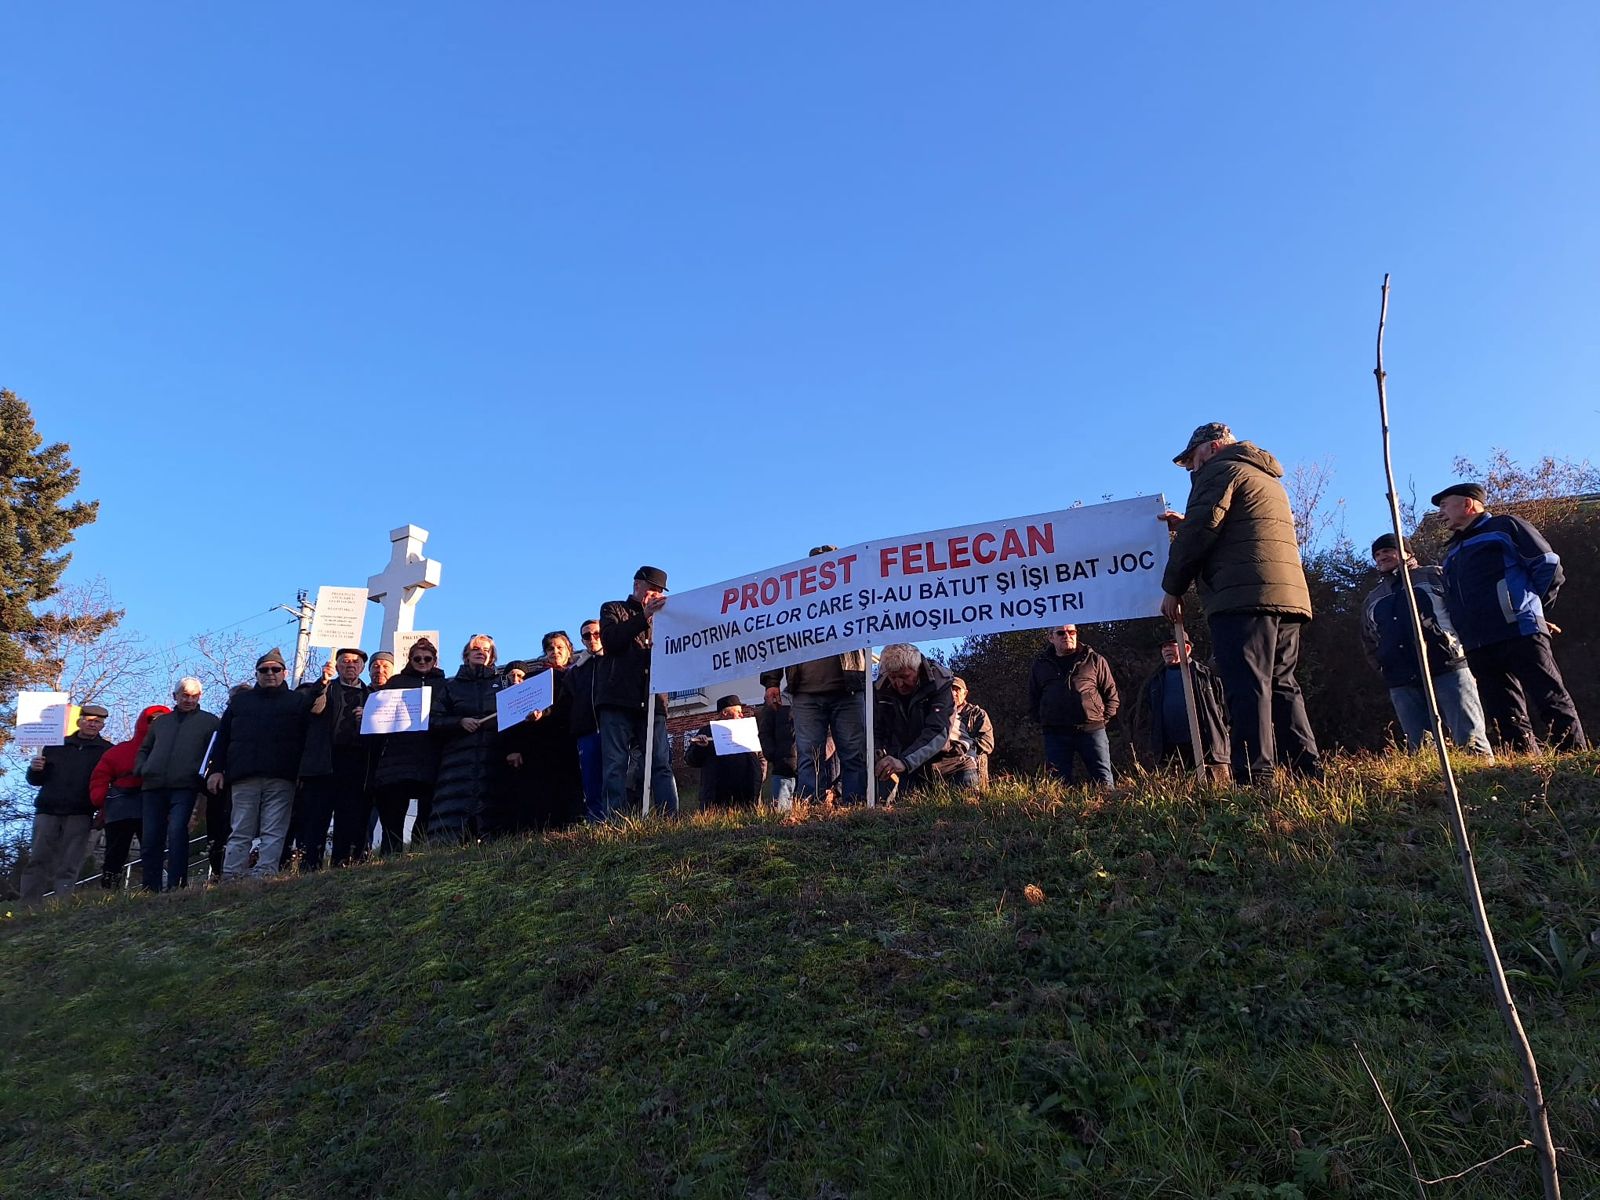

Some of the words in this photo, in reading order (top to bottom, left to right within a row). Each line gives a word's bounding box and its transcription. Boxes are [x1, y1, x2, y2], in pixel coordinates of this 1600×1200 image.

[664, 620, 741, 655] ÎMPOTRIVA
[743, 607, 802, 633] CELOR
[806, 592, 853, 620] CARE
[919, 574, 989, 600] BĂTUT
[1055, 557, 1100, 583] BAT
[1107, 550, 1155, 576] JOC
[720, 554, 857, 614] PROTEST
[880, 522, 1055, 578] FELECAN
[712, 651, 731, 671] DE
